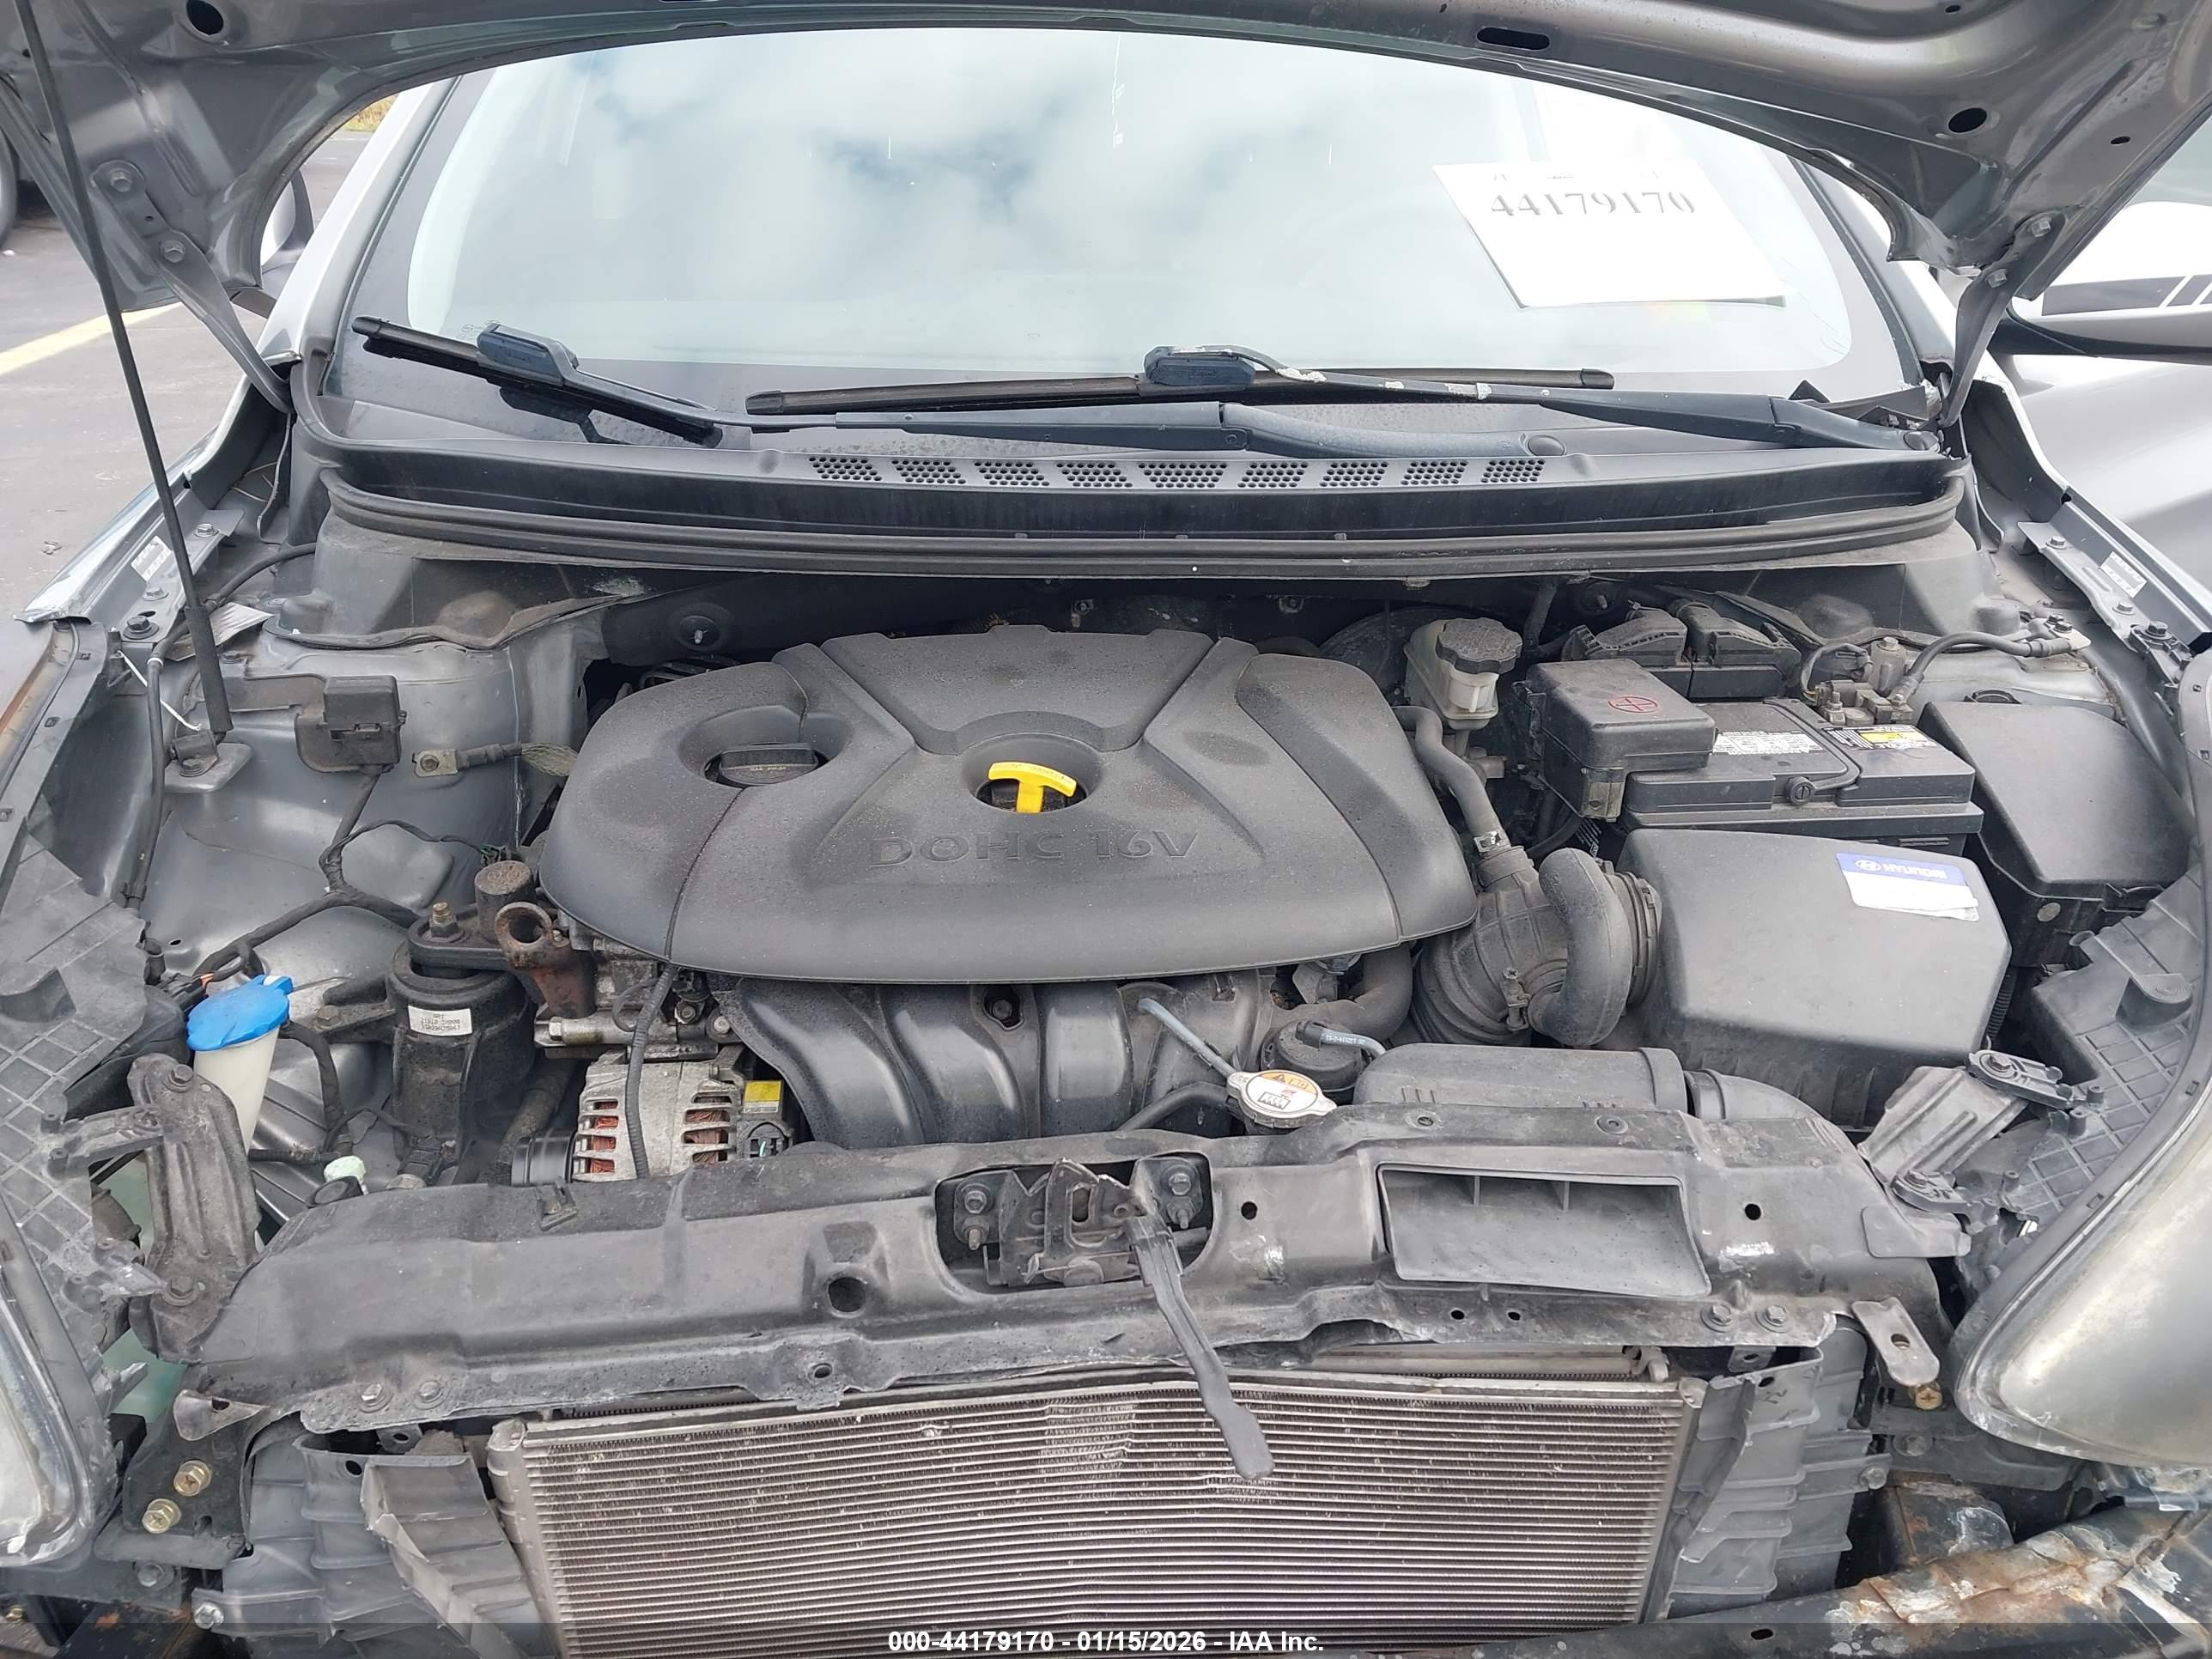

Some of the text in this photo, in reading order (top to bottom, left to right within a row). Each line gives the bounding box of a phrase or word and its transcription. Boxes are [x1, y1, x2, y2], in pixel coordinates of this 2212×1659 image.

[1491, 191, 1696, 216] 44179170
[870, 829, 1199, 867] DOHC 16V
[1883, 863, 1948, 880] HYUNDAI
